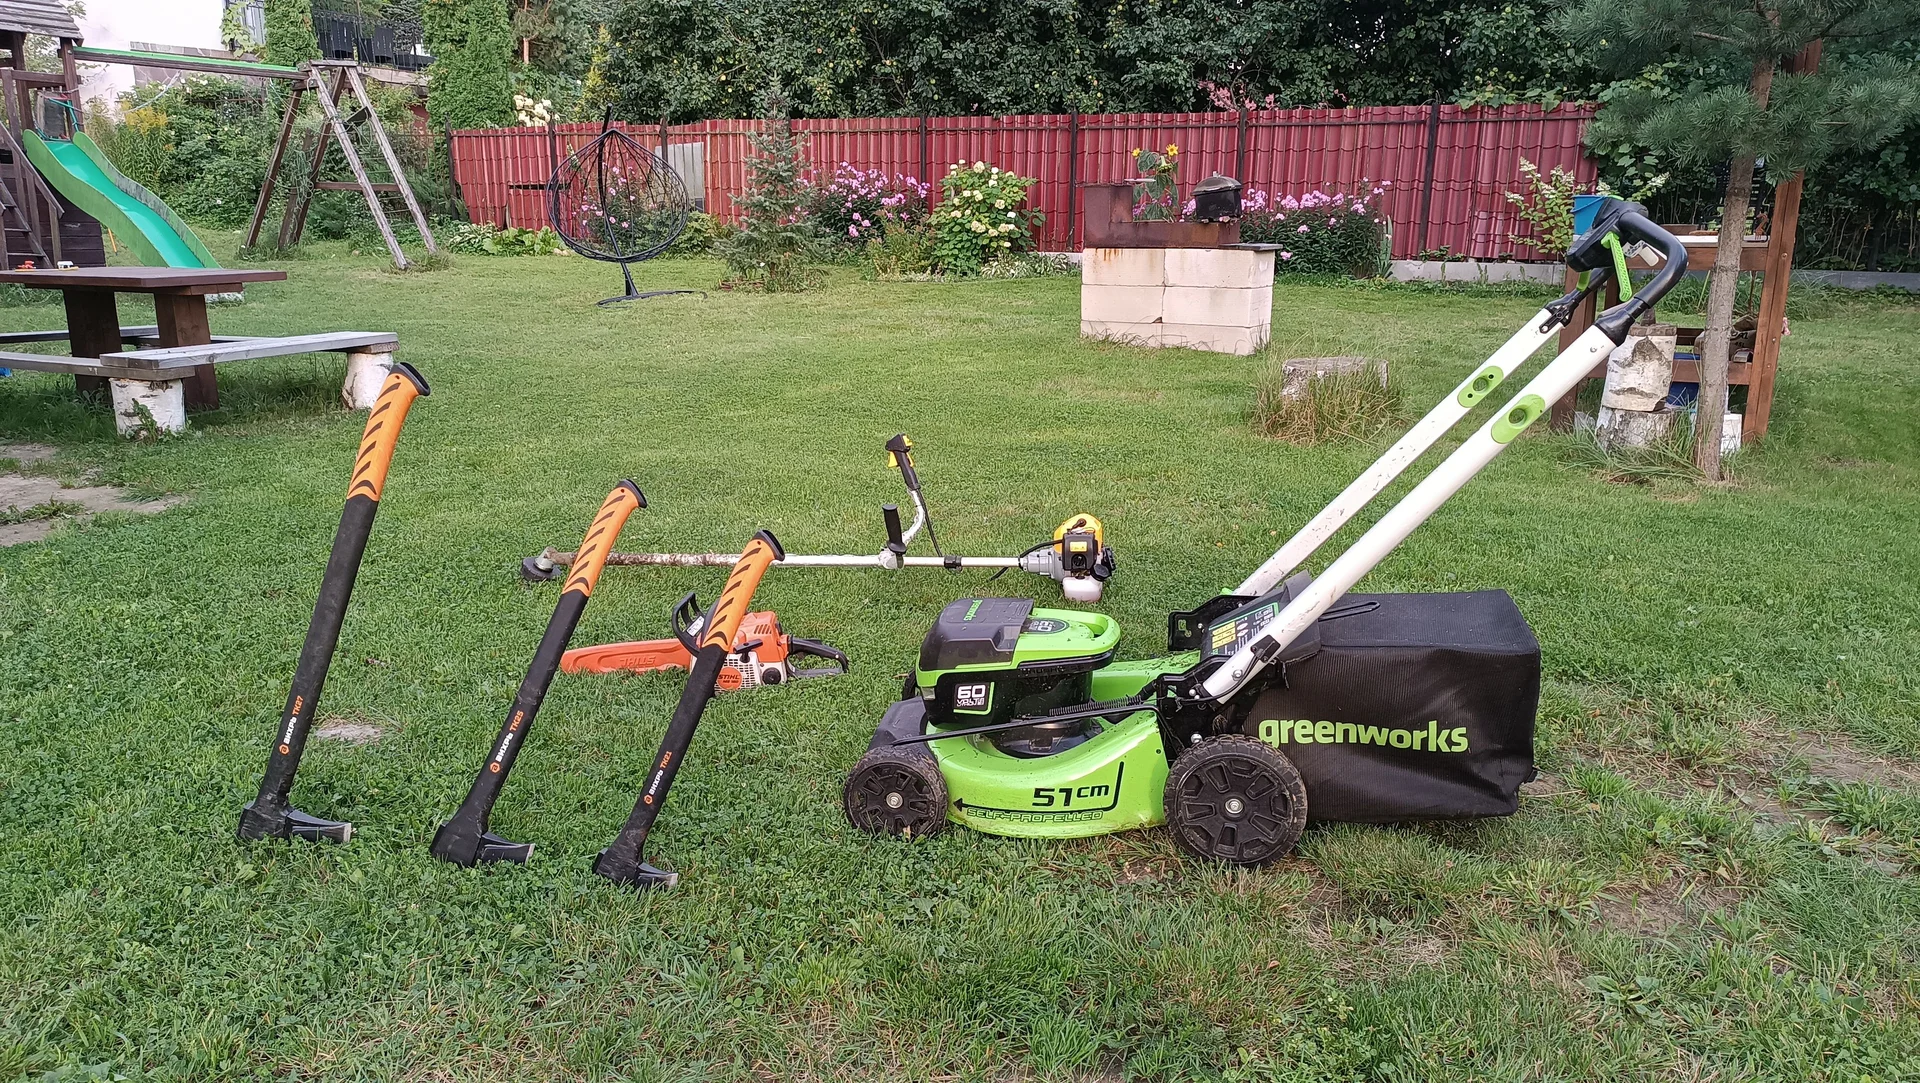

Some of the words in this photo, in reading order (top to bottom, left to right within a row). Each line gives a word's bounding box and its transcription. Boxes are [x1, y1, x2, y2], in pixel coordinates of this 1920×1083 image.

[619, 655, 656, 667] STIHL
[957, 684, 986, 699] 60
[1258, 719, 1468, 753] greenworks
[1032, 787, 1073, 807] 51
[1076, 785, 1110, 798] cm
[966, 808, 1103, 824] SELF-PROPELLED
